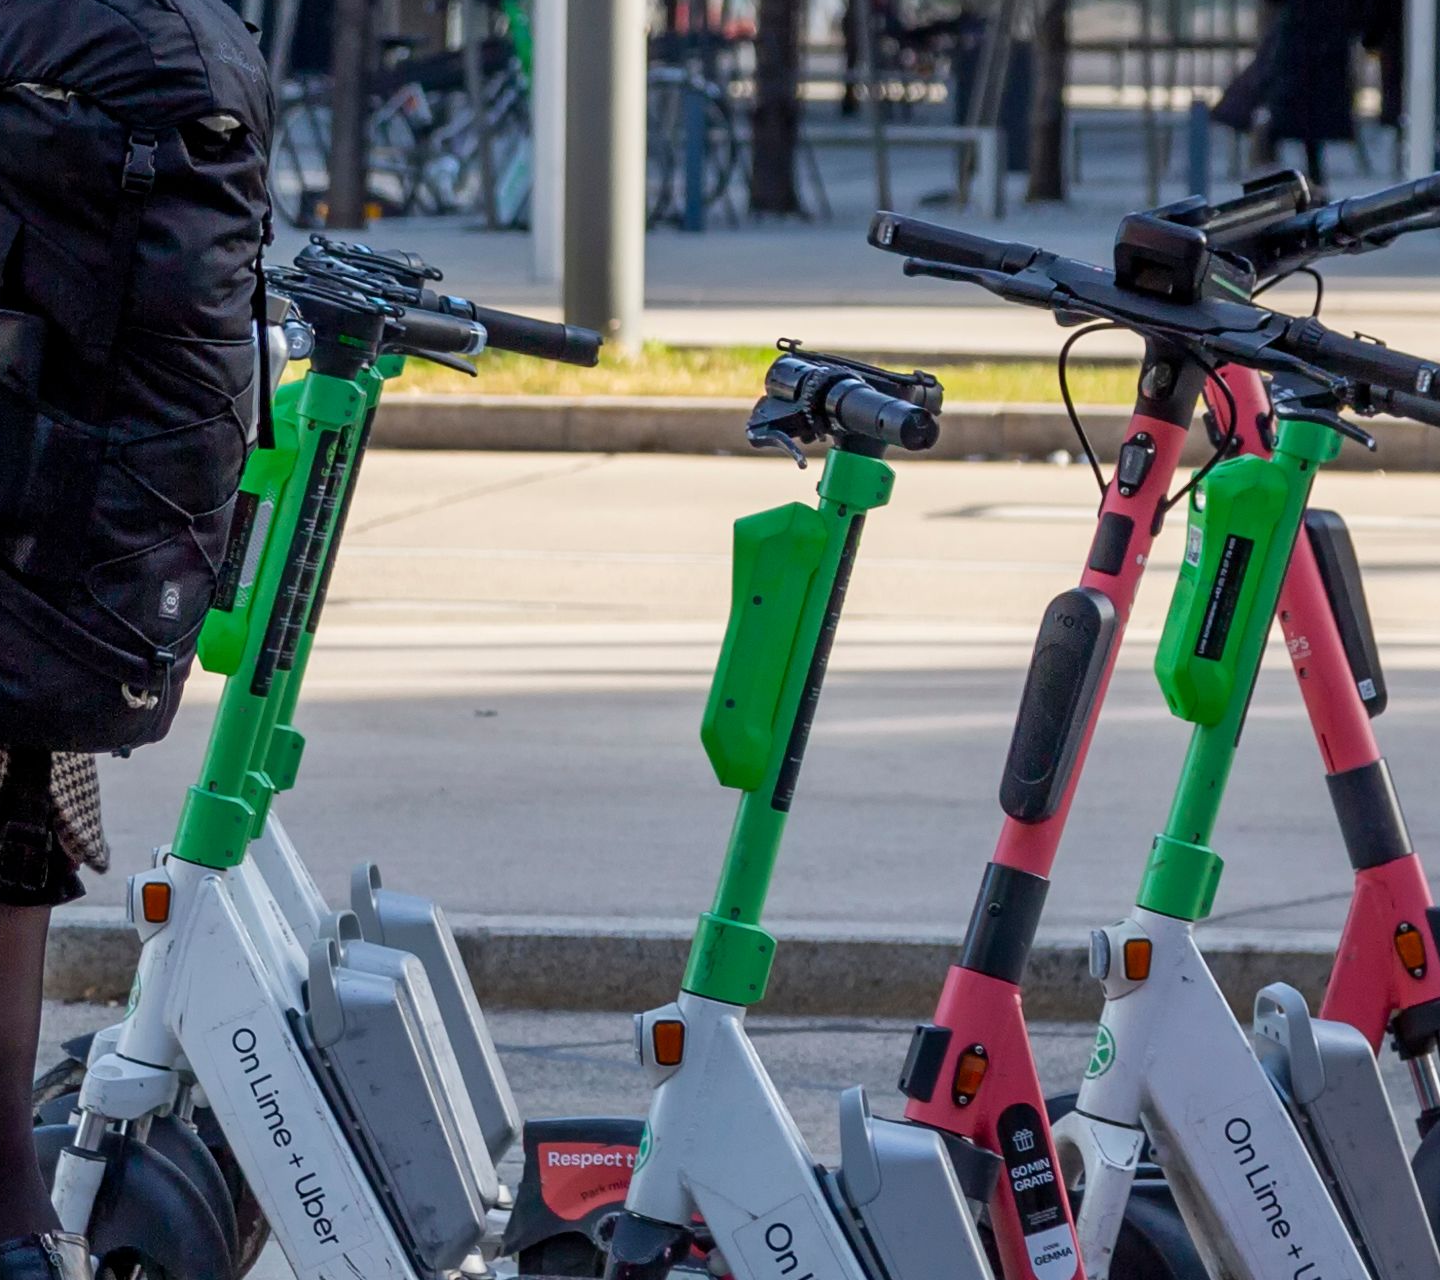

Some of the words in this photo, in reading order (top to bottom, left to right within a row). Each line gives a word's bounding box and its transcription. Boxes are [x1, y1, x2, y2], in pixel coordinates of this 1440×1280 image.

[232, 1028, 260, 1074] On
[250, 1074, 293, 1148] Lime
[288, 1153, 305, 1169] +
[547, 1151, 623, 1169] Respect
[1011, 1164, 1027, 1180] 60
[1027, 1157, 1052, 1175] MIN
[580, 1185, 607, 1201] Park
[1013, 1171, 1055, 1193] GRATIS
[1224, 1117, 1256, 1166] On
[1245, 1164, 1291, 1240] Lime
[1287, 1244, 1303, 1260] +
[294, 1172, 340, 1246] Uber
[765, 1222, 798, 1276] On
[1034, 1247, 1073, 1267] GEMMA
